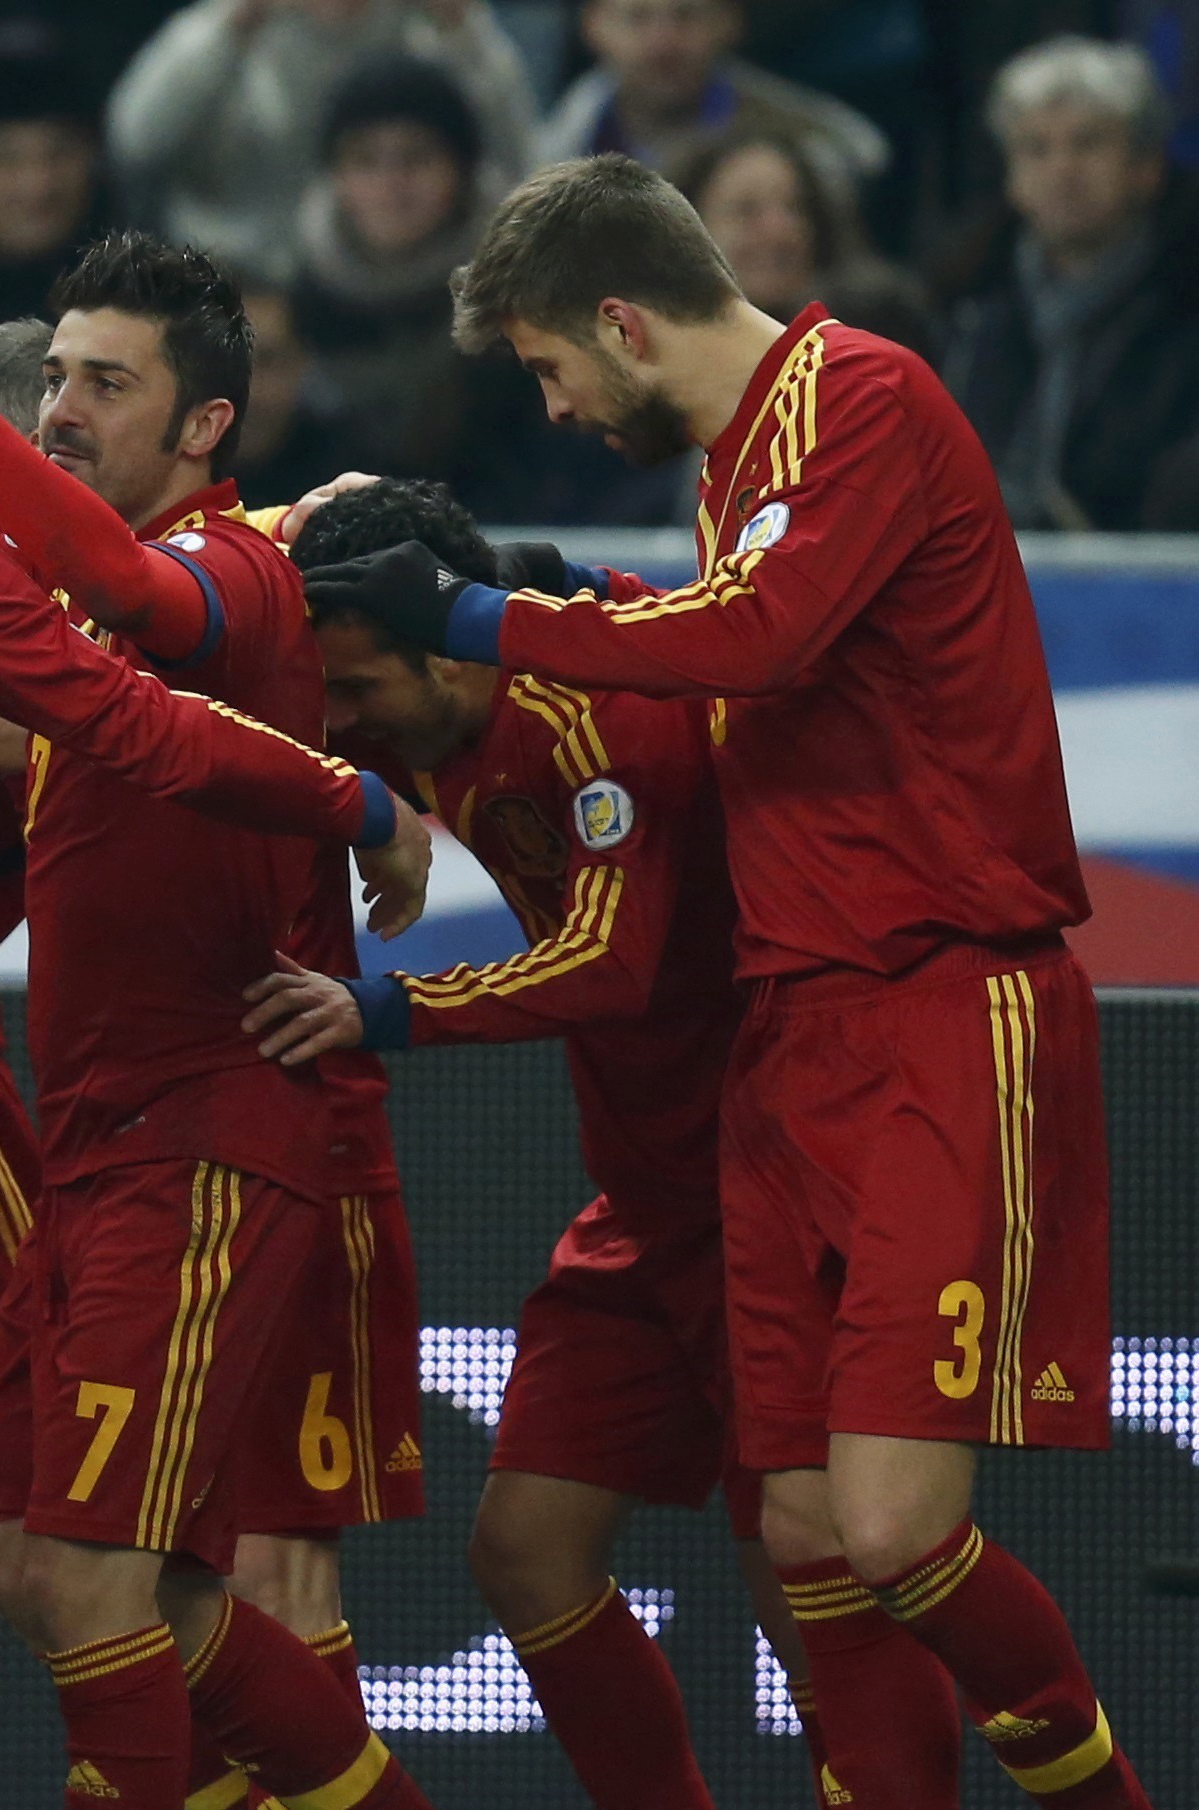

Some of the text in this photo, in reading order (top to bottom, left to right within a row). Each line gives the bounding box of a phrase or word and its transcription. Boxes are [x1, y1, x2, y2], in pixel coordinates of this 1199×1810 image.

[933, 1279, 986, 1399] 3
[1031, 1386, 1075, 1402] adidas
[66, 1380, 136, 1503] 7
[299, 1371, 353, 1492] 6
